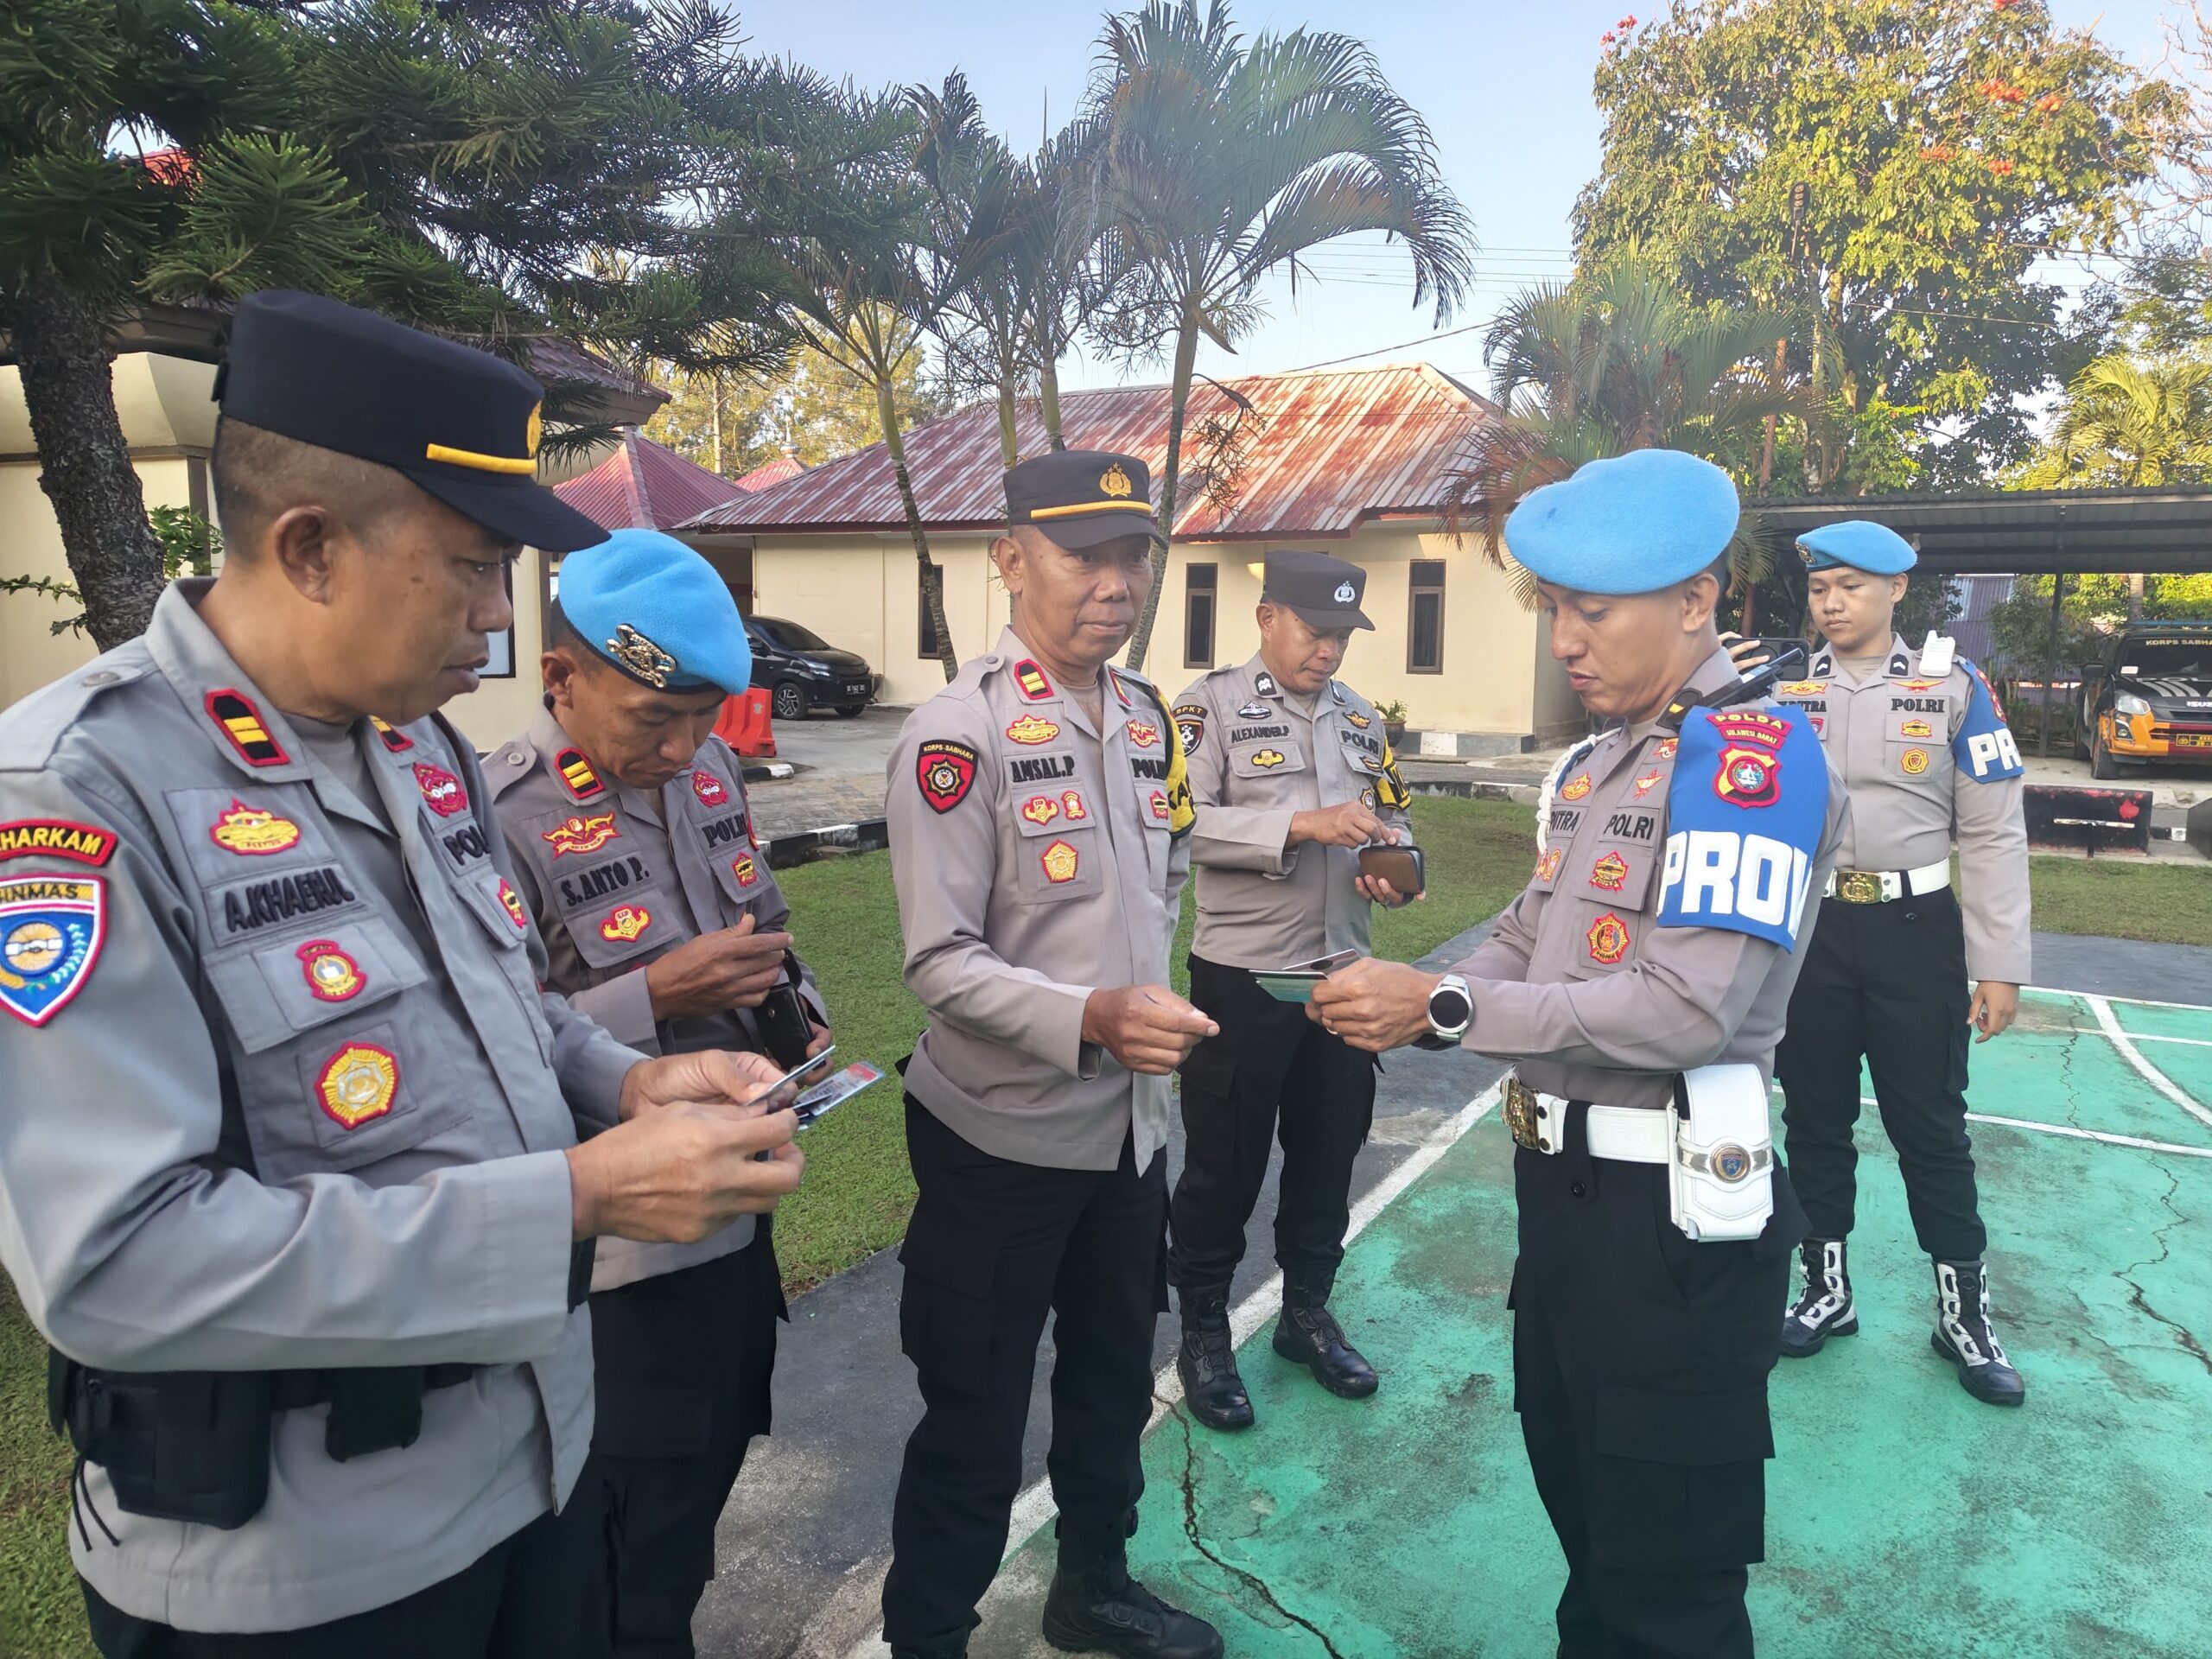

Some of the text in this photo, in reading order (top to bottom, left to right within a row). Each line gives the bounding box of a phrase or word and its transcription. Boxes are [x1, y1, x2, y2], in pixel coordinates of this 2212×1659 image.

[1891, 698, 1945, 713] POLRI
[1715, 713, 1782, 729] POLDA
[1341, 730, 1379, 754] POLRI
[1757, 731, 1777, 744] BARAT
[945, 746, 974, 760] SABHARA
[1010, 755, 1075, 783] AMSAL.P
[1603, 814, 1654, 840] POLRI
[626, 857, 650, 881] P.
[0, 882, 78, 904] INMAS
